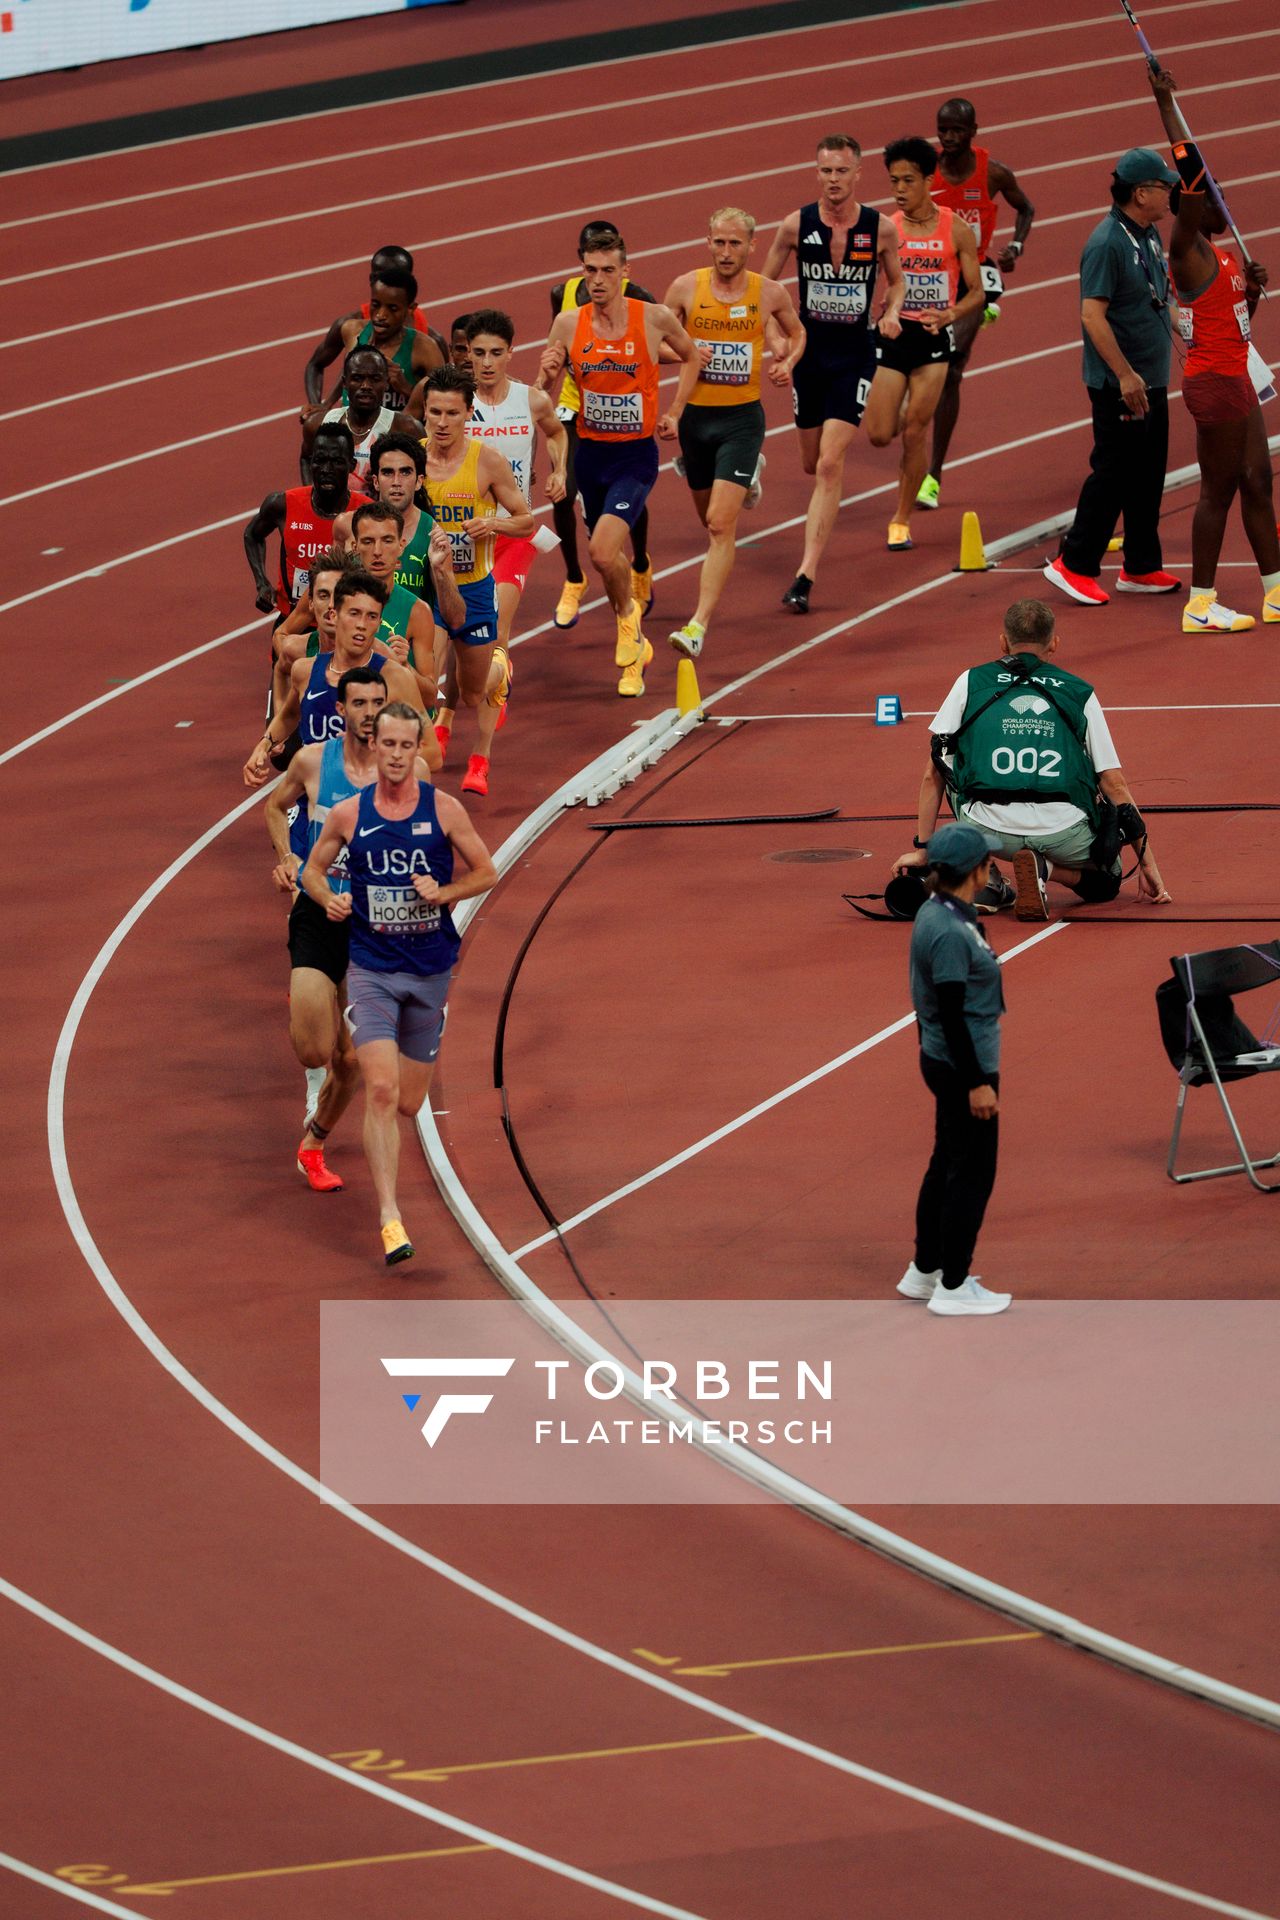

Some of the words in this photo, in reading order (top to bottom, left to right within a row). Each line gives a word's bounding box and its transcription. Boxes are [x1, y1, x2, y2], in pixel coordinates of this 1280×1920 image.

[802, 261, 873, 280] NORWAY
[906, 274, 943, 286] TDK
[823, 284, 862, 297] TDK
[694, 316, 758, 332] GERMANY
[708, 342, 748, 356] TDK
[597, 394, 638, 407] TDK
[586, 406, 640, 422] FOPPEN
[299, 521, 314, 531] UBS
[877, 697, 897, 722] E
[1002, 723, 1055, 732] CHAMPIONSHIPS
[1025, 718, 1056, 727] ATHLETICS
[991, 746, 1062, 777] 002
[366, 849, 432, 876] USA
[373, 904, 437, 921] HOCKER
